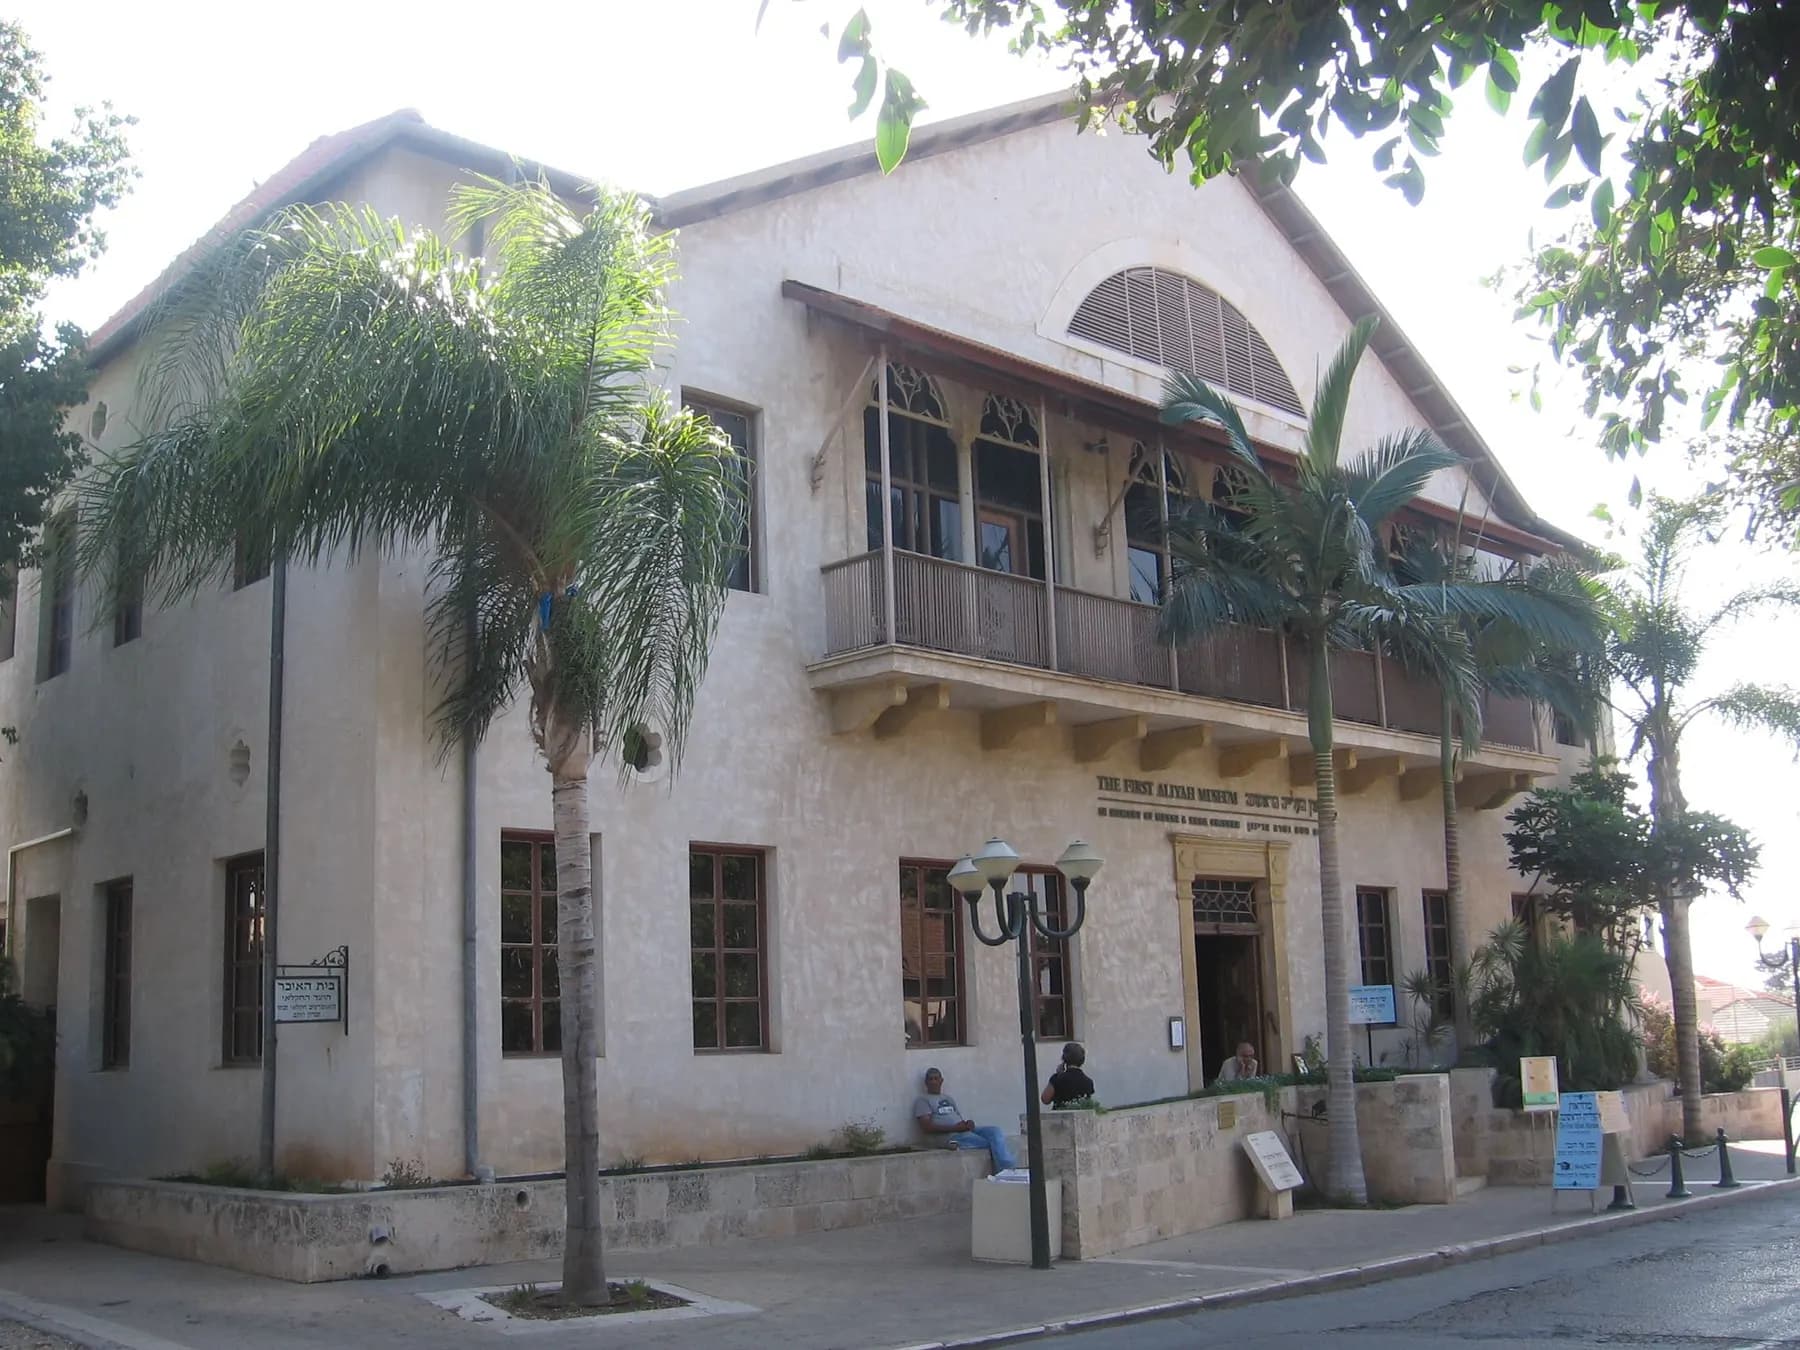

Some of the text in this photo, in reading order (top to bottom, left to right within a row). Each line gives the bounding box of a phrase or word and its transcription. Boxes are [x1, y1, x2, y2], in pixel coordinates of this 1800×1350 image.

[1097, 776, 1238, 805] THE FIRST ALIYAH MUSEUM
[316, 982, 335, 991] בית
